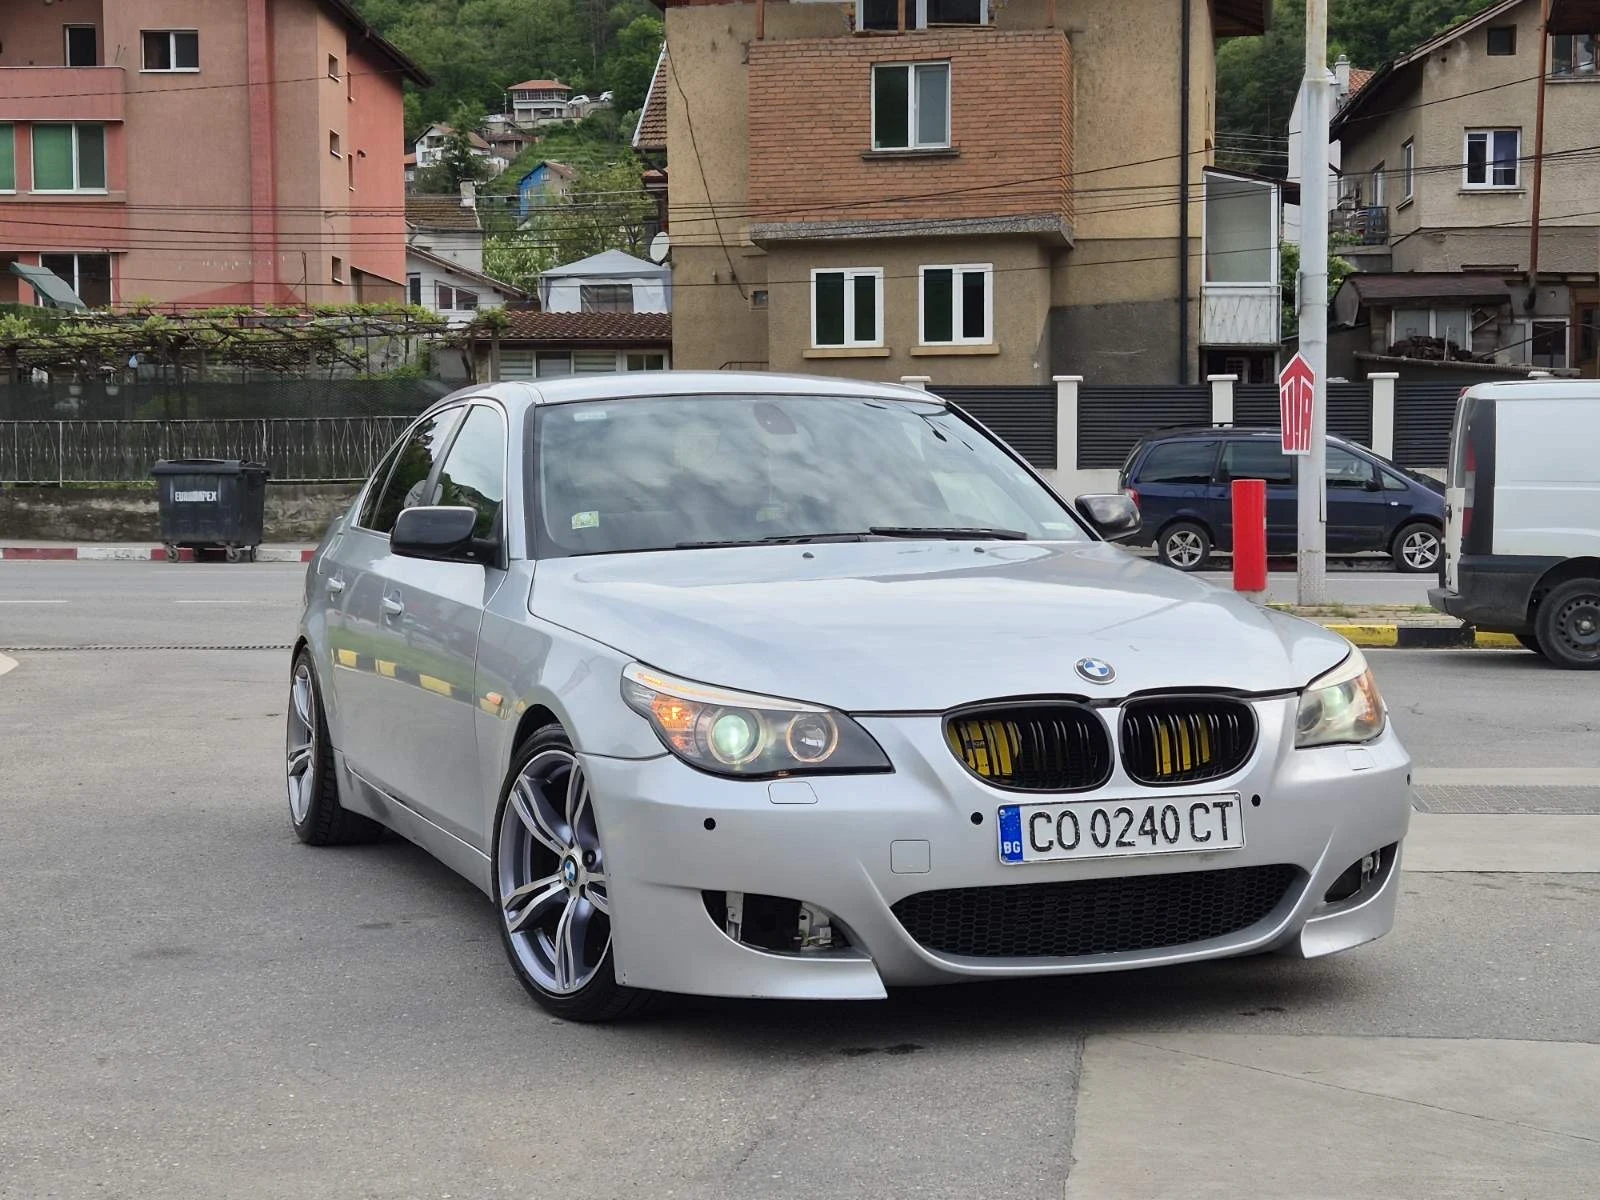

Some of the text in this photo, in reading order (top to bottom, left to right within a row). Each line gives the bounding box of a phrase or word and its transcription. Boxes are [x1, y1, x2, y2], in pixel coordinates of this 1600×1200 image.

[1029, 801, 1233, 852] CO 0240 CT
[1003, 841, 1021, 854] BG
